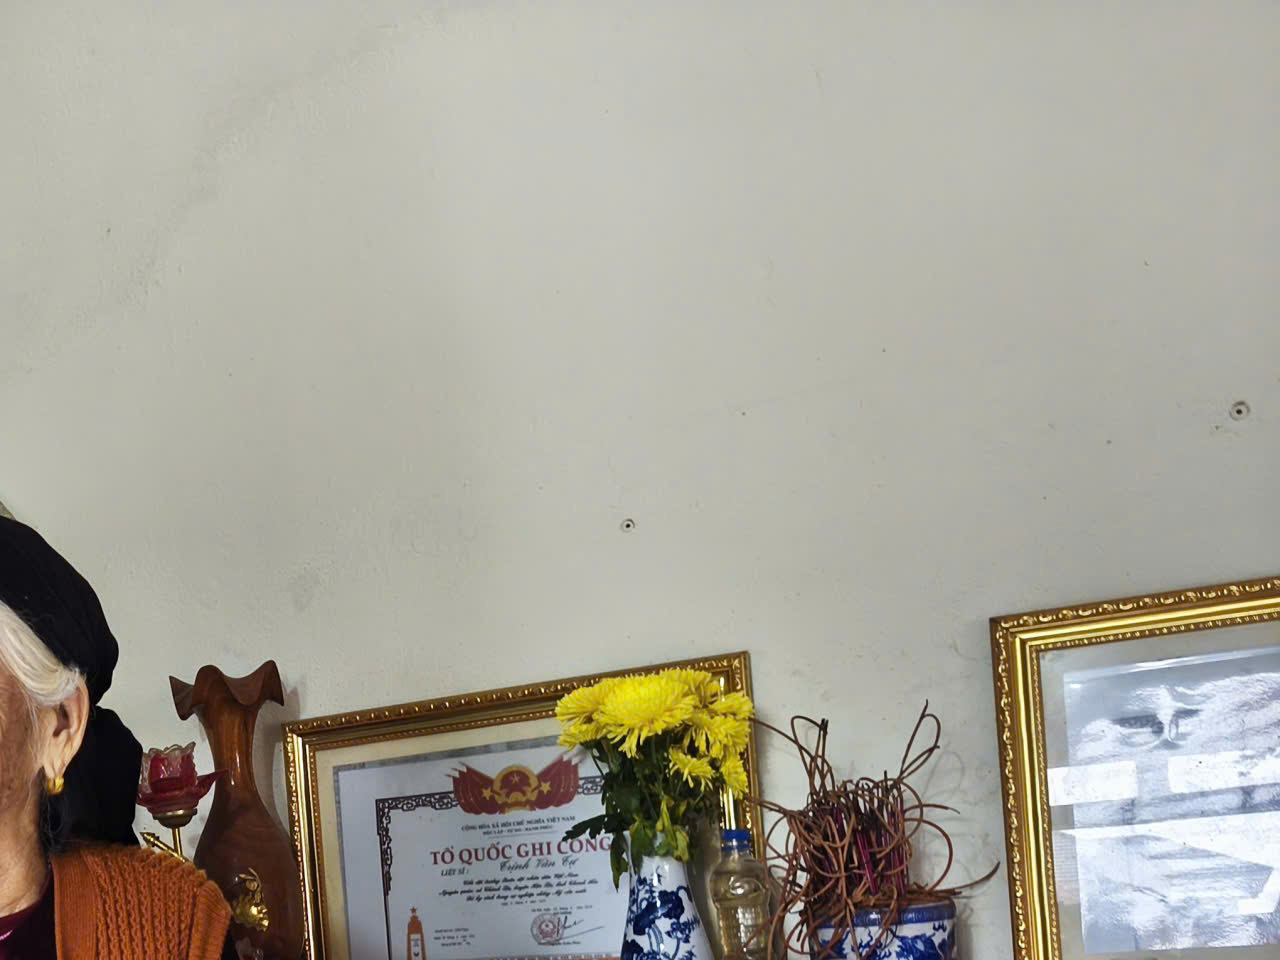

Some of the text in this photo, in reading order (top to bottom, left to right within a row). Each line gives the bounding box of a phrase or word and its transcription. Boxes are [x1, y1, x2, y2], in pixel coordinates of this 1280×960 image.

[430, 845, 455, 865] TỔ
[458, 841, 512, 865] QUỐC
[516, 841, 552, 858] GHI
